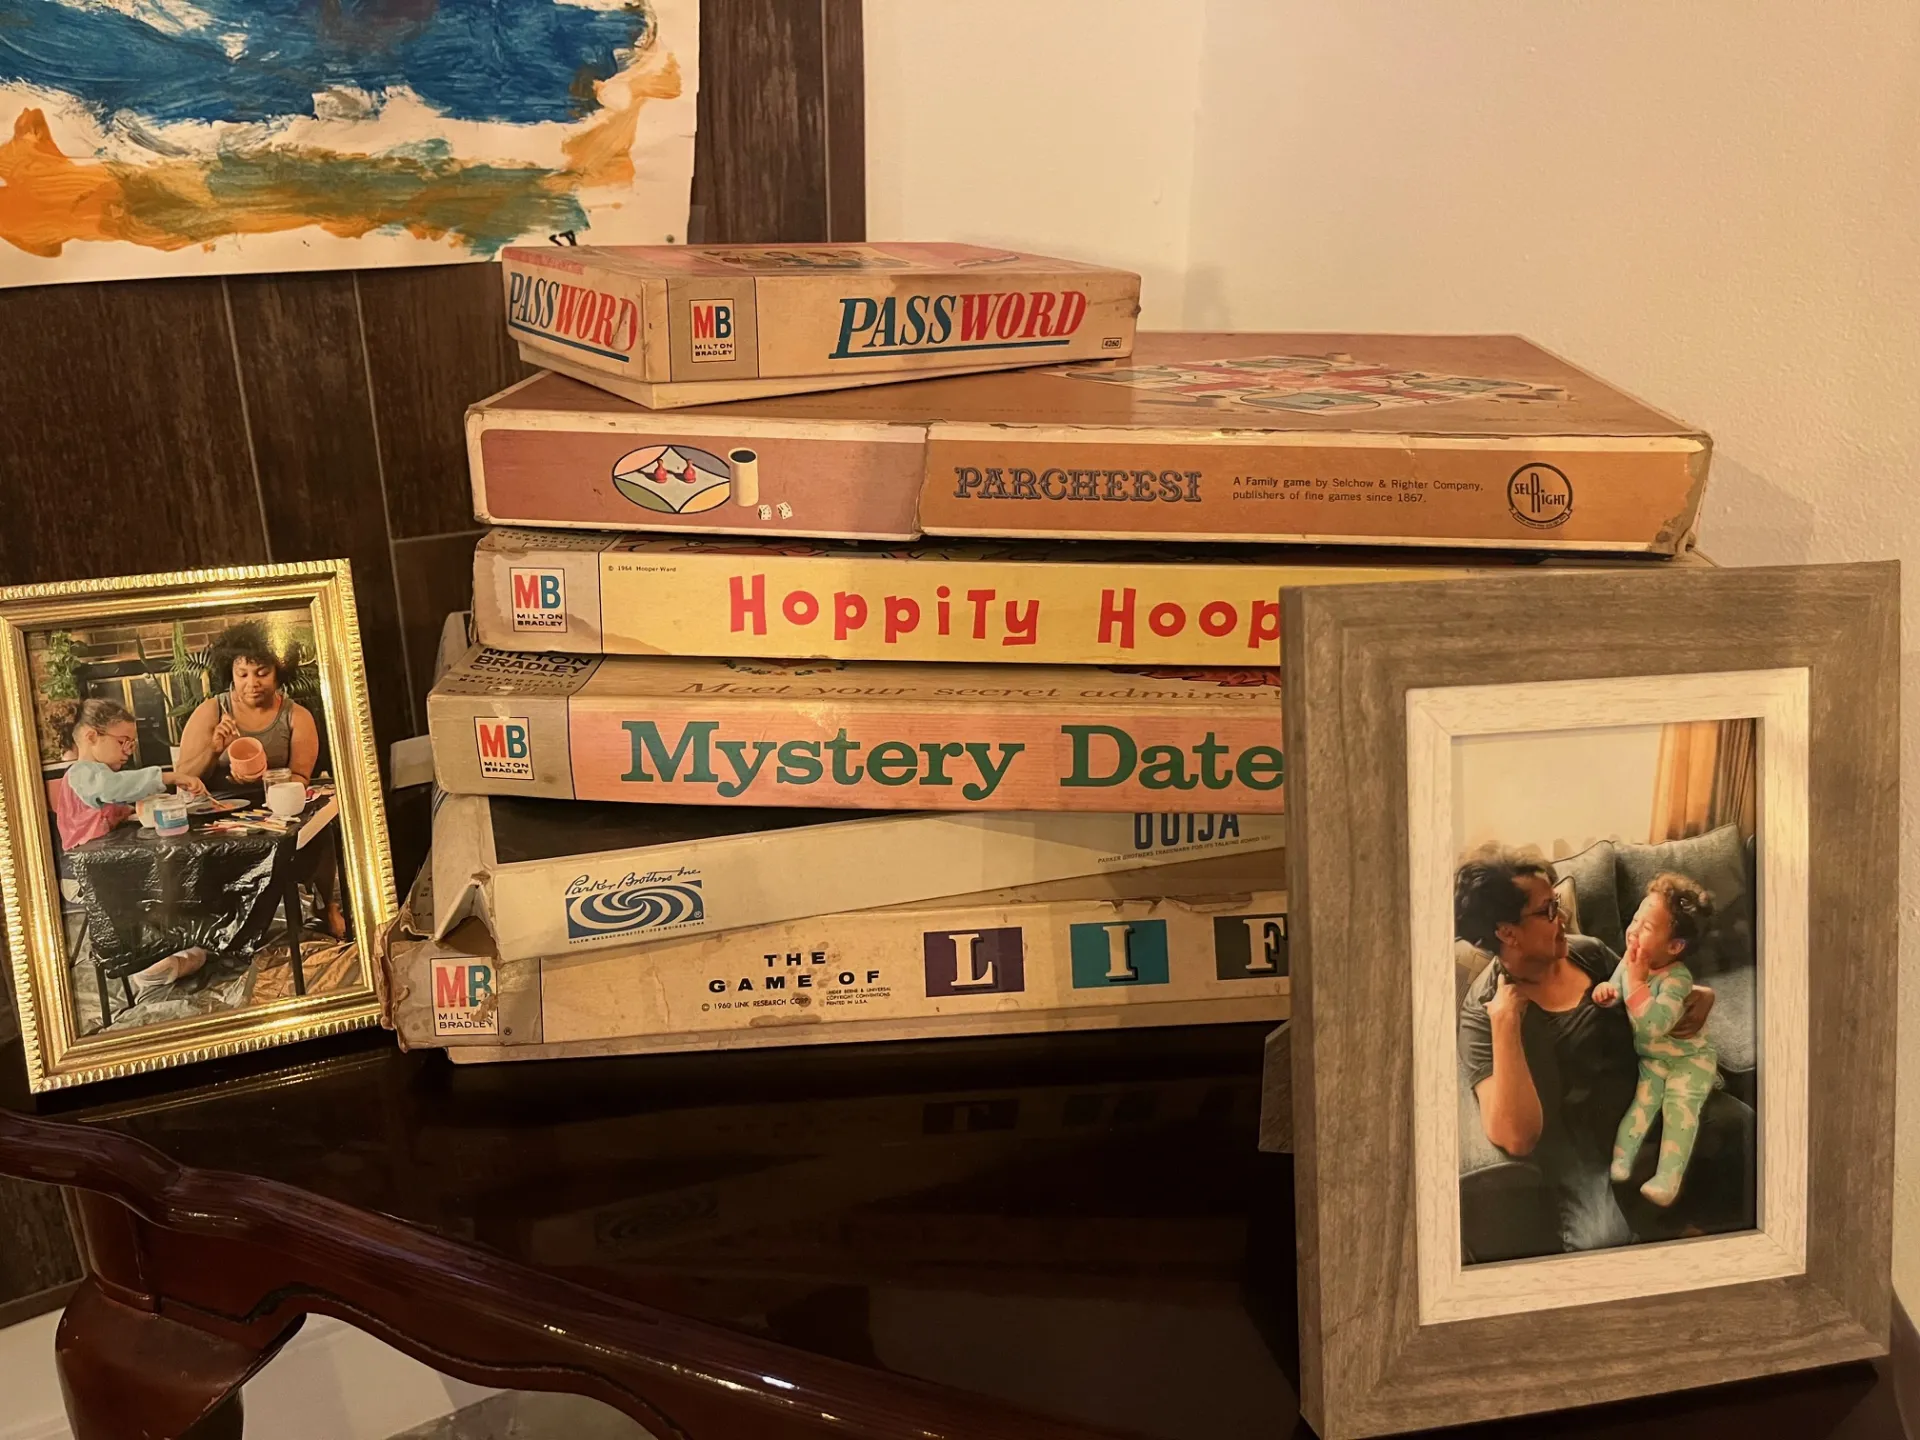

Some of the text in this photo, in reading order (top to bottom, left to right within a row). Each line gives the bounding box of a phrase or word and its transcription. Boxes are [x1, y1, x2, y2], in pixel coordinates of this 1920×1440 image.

[508, 271, 638, 352] PASSWORD
[693, 306, 731, 339] MB
[828, 291, 1086, 359] PASSWORD
[953, 467, 1202, 502] PARCHEESI
[1233, 477, 1240, 485] A
[1246, 477, 1278, 488] Family
[1283, 479, 1311, 488] game
[1316, 478, 1328, 489] by
[1332, 478, 1374, 488] Selchow
[1379, 480, 1386, 488] &
[1391, 479, 1428, 490] Righter
[1233, 491, 1285, 500] publishers
[1289, 491, 1299, 500] of
[1305, 491, 1324, 500] fine
[1328, 493, 1361, 502] games
[514, 574, 561, 609] MB
[474, 655, 587, 673] BRADLEY
[481, 648, 592, 666] MILTON
[470, 664, 579, 678] COMPANY
[678, 682, 791, 694] Meet
[805, 686, 916, 696] your
[933, 687, 1060, 696] secret
[480, 725, 528, 758] MB
[484, 761, 529, 769] MILTON
[621, 721, 1283, 800] Mystery Date
[1134, 812, 1239, 850] OUIJA
[764, 952, 826, 967] THE
[709, 970, 879, 993] GAME OF
[753, 998, 786, 1006] RESEARCH
[438, 1012, 493, 1020] MILTN
[440, 1020, 492, 1029] BRADLEY
